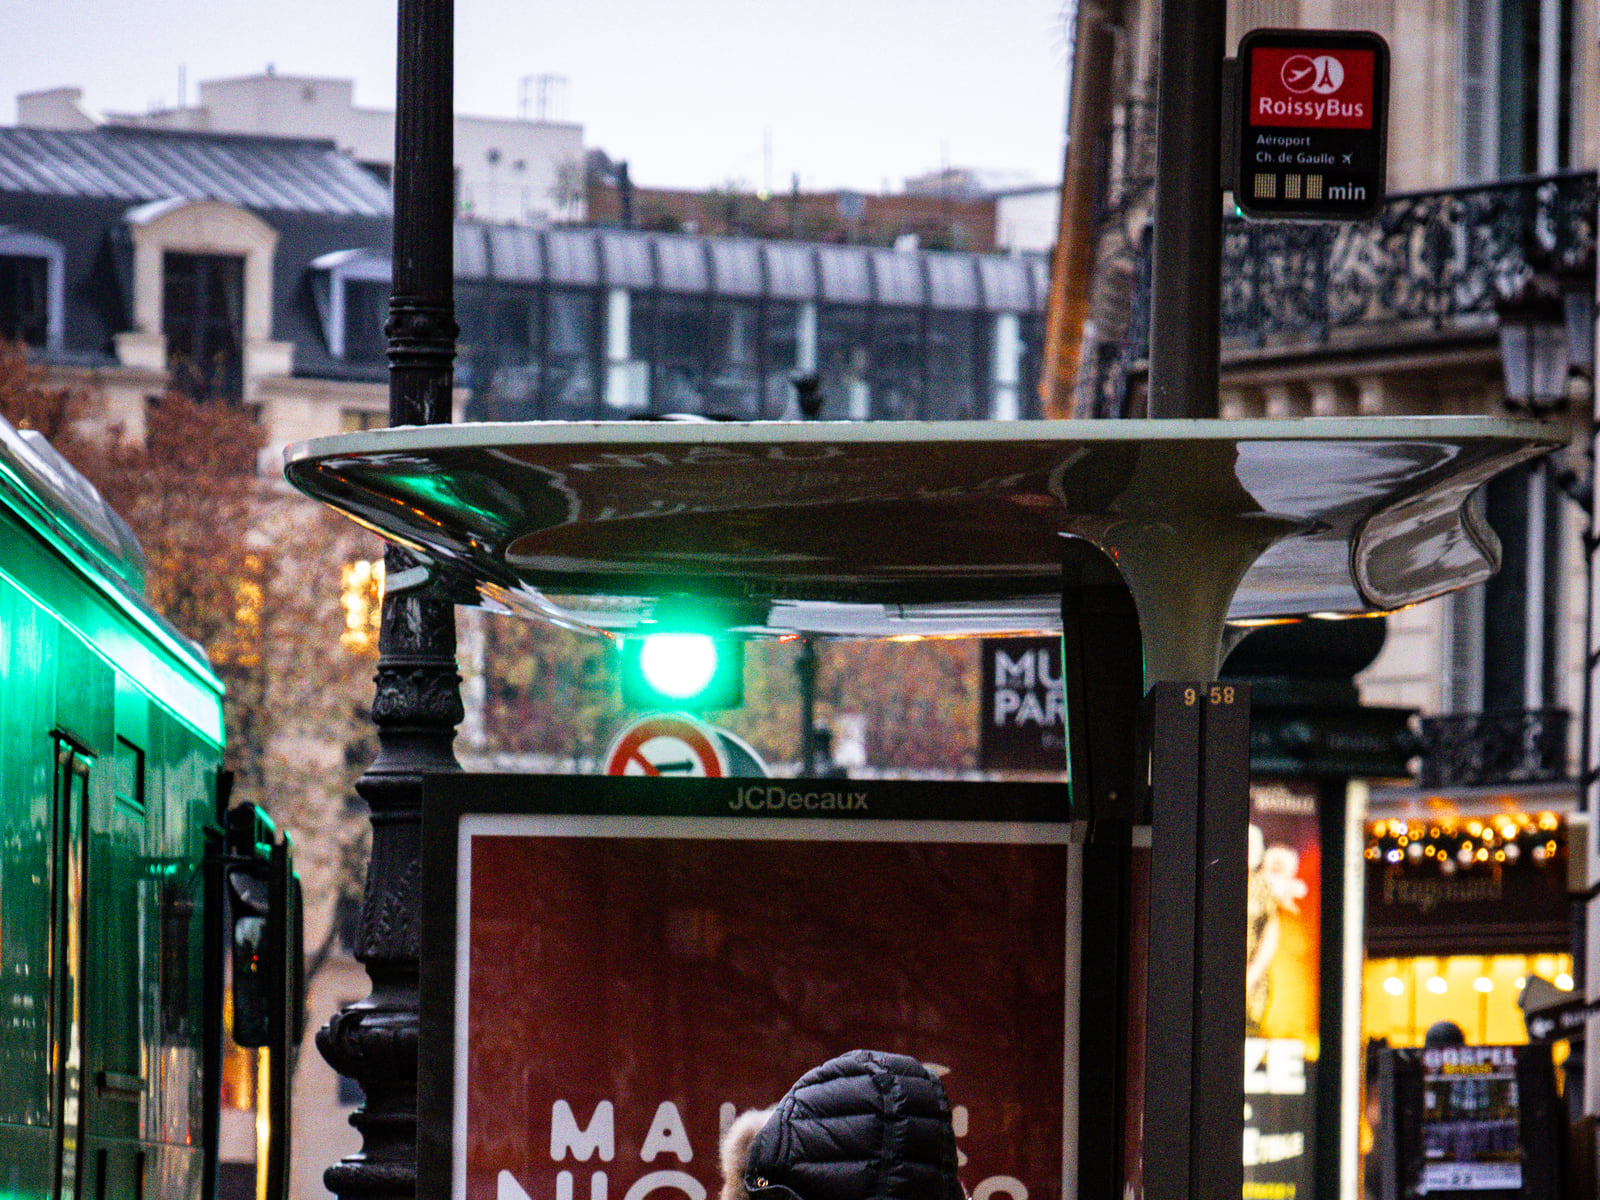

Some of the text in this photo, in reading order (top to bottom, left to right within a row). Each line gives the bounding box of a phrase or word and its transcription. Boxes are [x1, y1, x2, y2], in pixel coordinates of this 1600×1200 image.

[1259, 96, 1364, 120] RoissyBus
[1256, 151, 1335, 165] Ch. de Gaulle
[1328, 182, 1366, 200] min
[728, 786, 869, 810] JCDecaux
